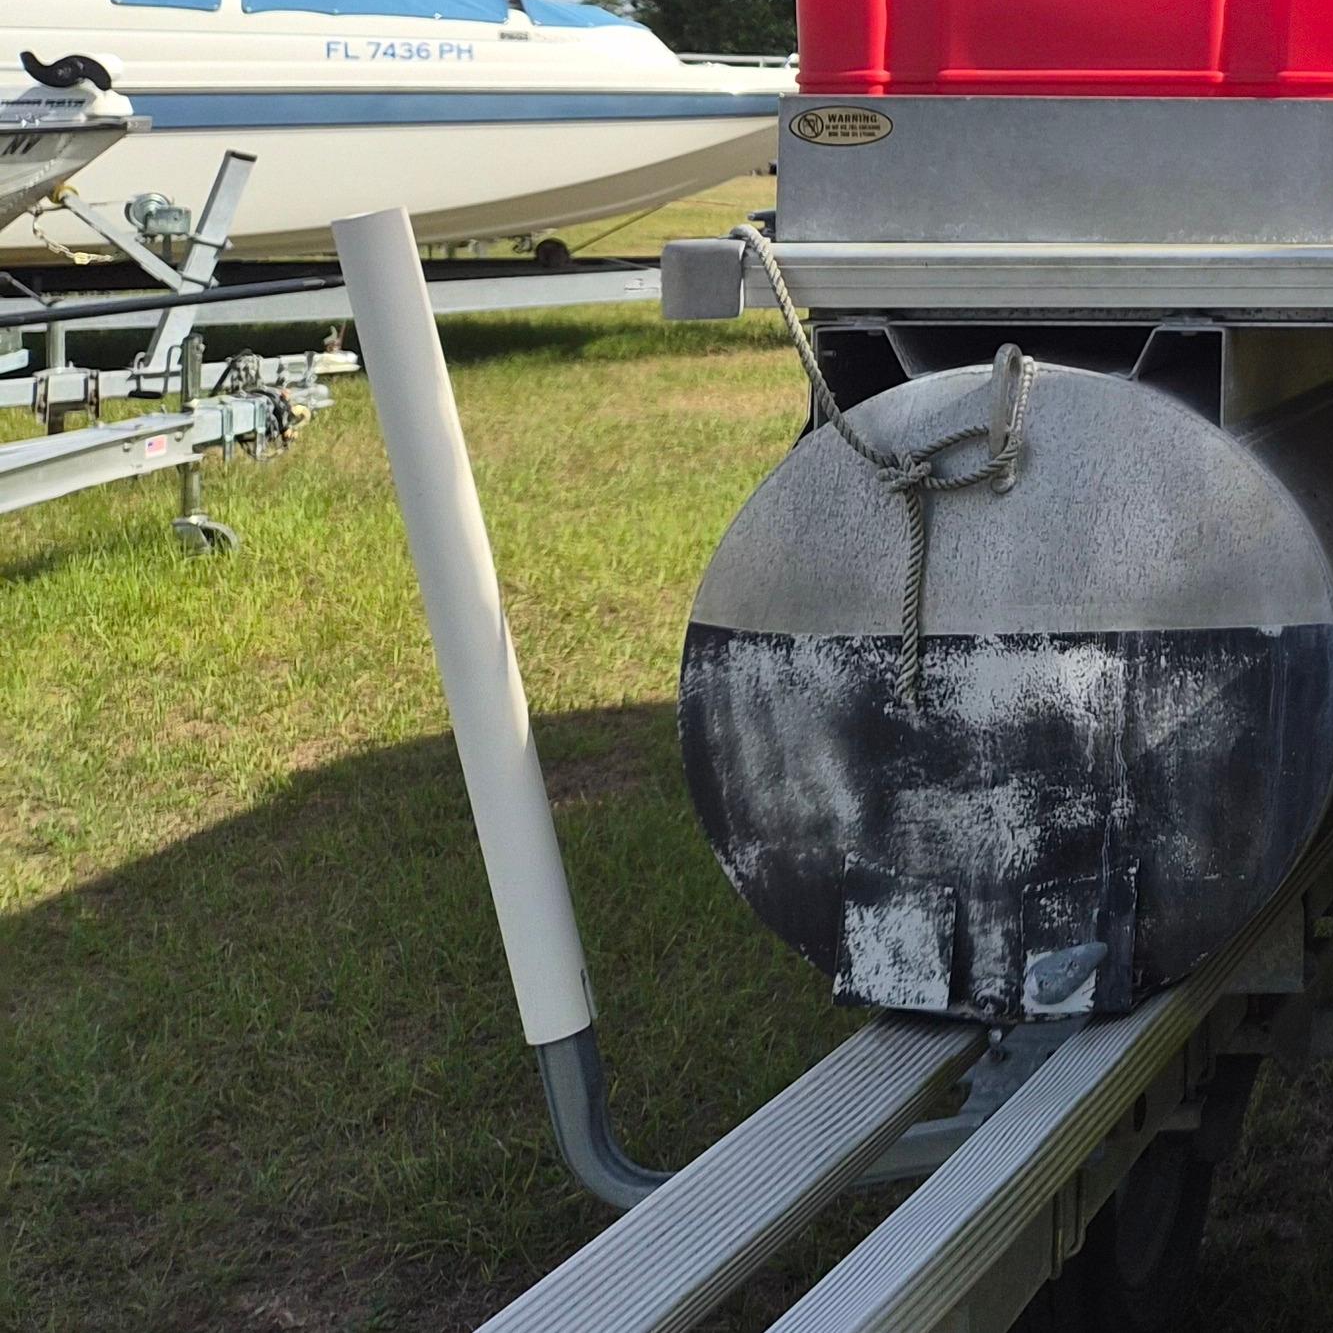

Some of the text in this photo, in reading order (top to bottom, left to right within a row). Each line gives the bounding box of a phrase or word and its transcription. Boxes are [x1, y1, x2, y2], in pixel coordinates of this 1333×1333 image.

[326, 41, 474, 61] FL 7436 PH
[827, 114, 878, 123] WARNING
